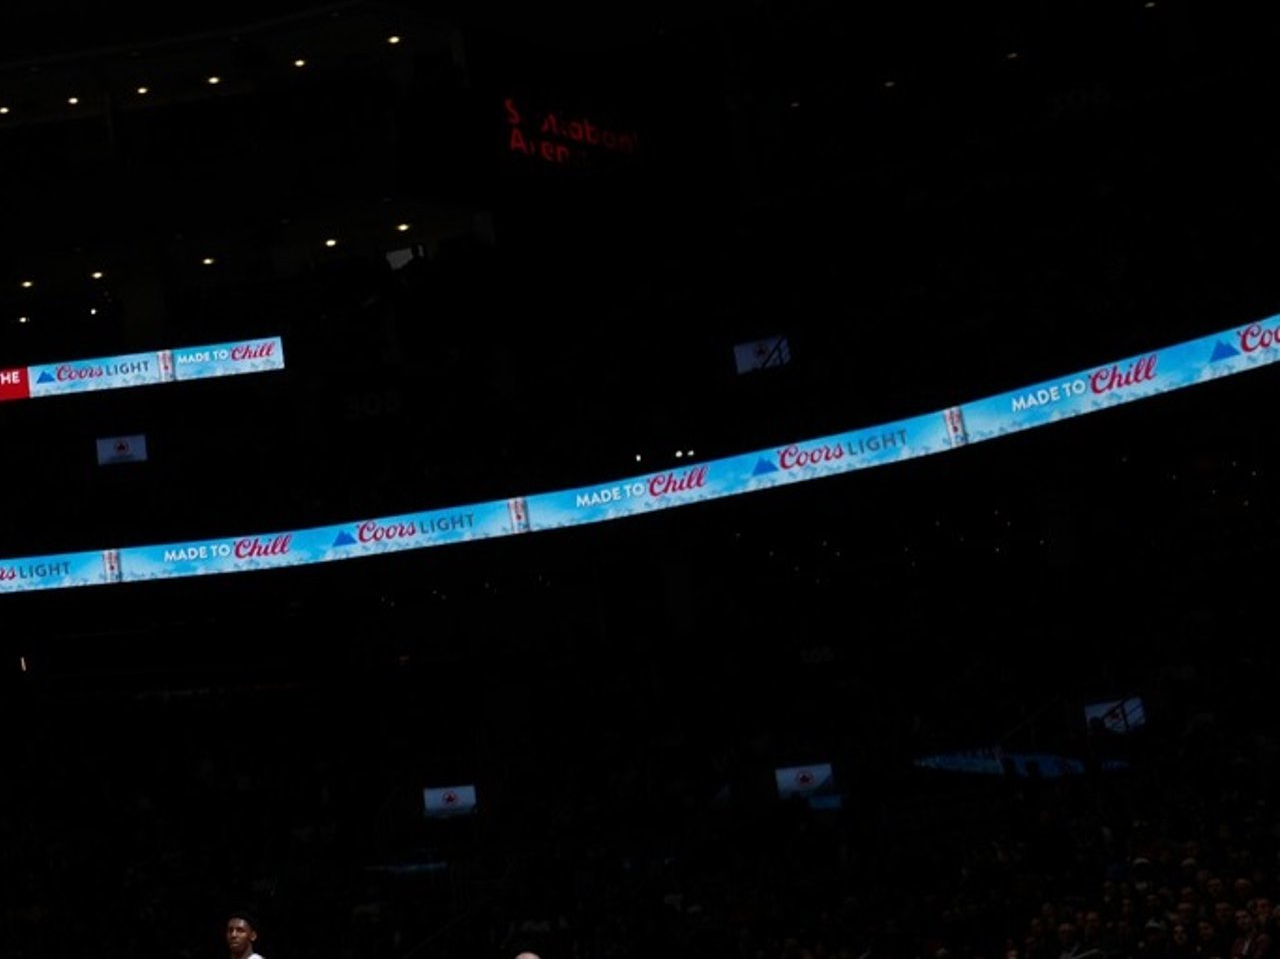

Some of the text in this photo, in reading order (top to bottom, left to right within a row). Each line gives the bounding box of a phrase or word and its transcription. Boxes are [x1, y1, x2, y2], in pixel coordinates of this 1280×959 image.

[177, 343, 275, 364] MADE TO Chill
[55, 360, 150, 381] Coors LIGHT
[1011, 354, 1157, 413] MADE TO Chill
[18, 560, 71, 579] LIGHT
